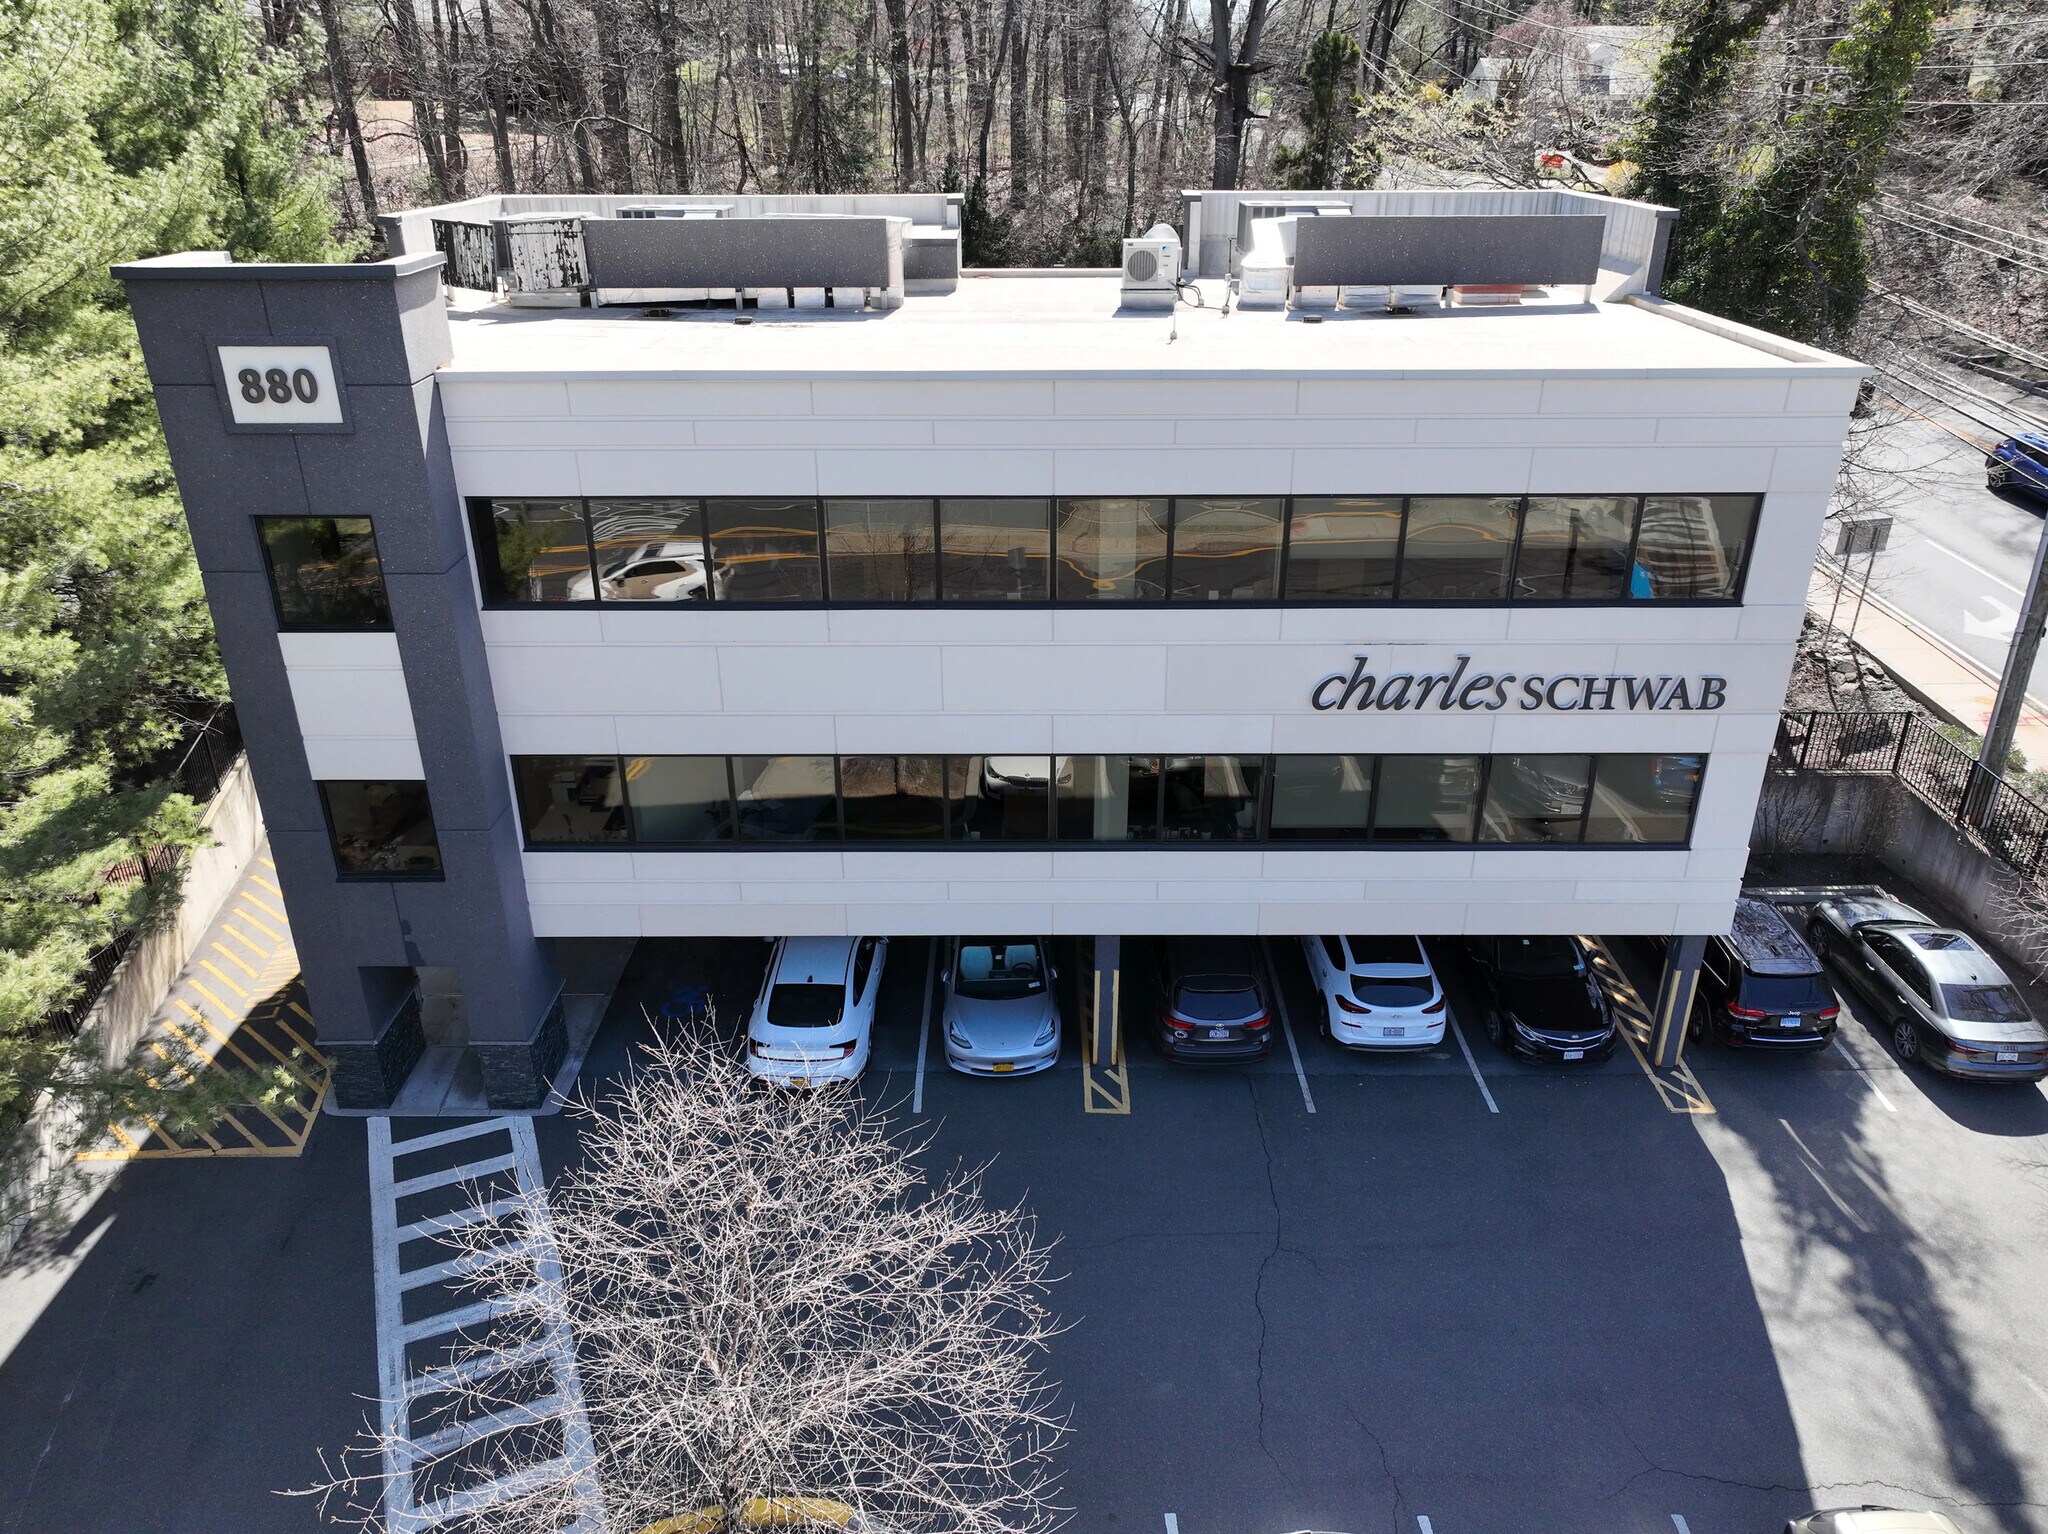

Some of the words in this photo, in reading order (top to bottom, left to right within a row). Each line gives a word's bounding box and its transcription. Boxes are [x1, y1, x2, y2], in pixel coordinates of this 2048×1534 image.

[238, 368, 319, 404] 880
[1311, 654, 1517, 711] charles
[1519, 675, 1728, 711] SCHWAB
